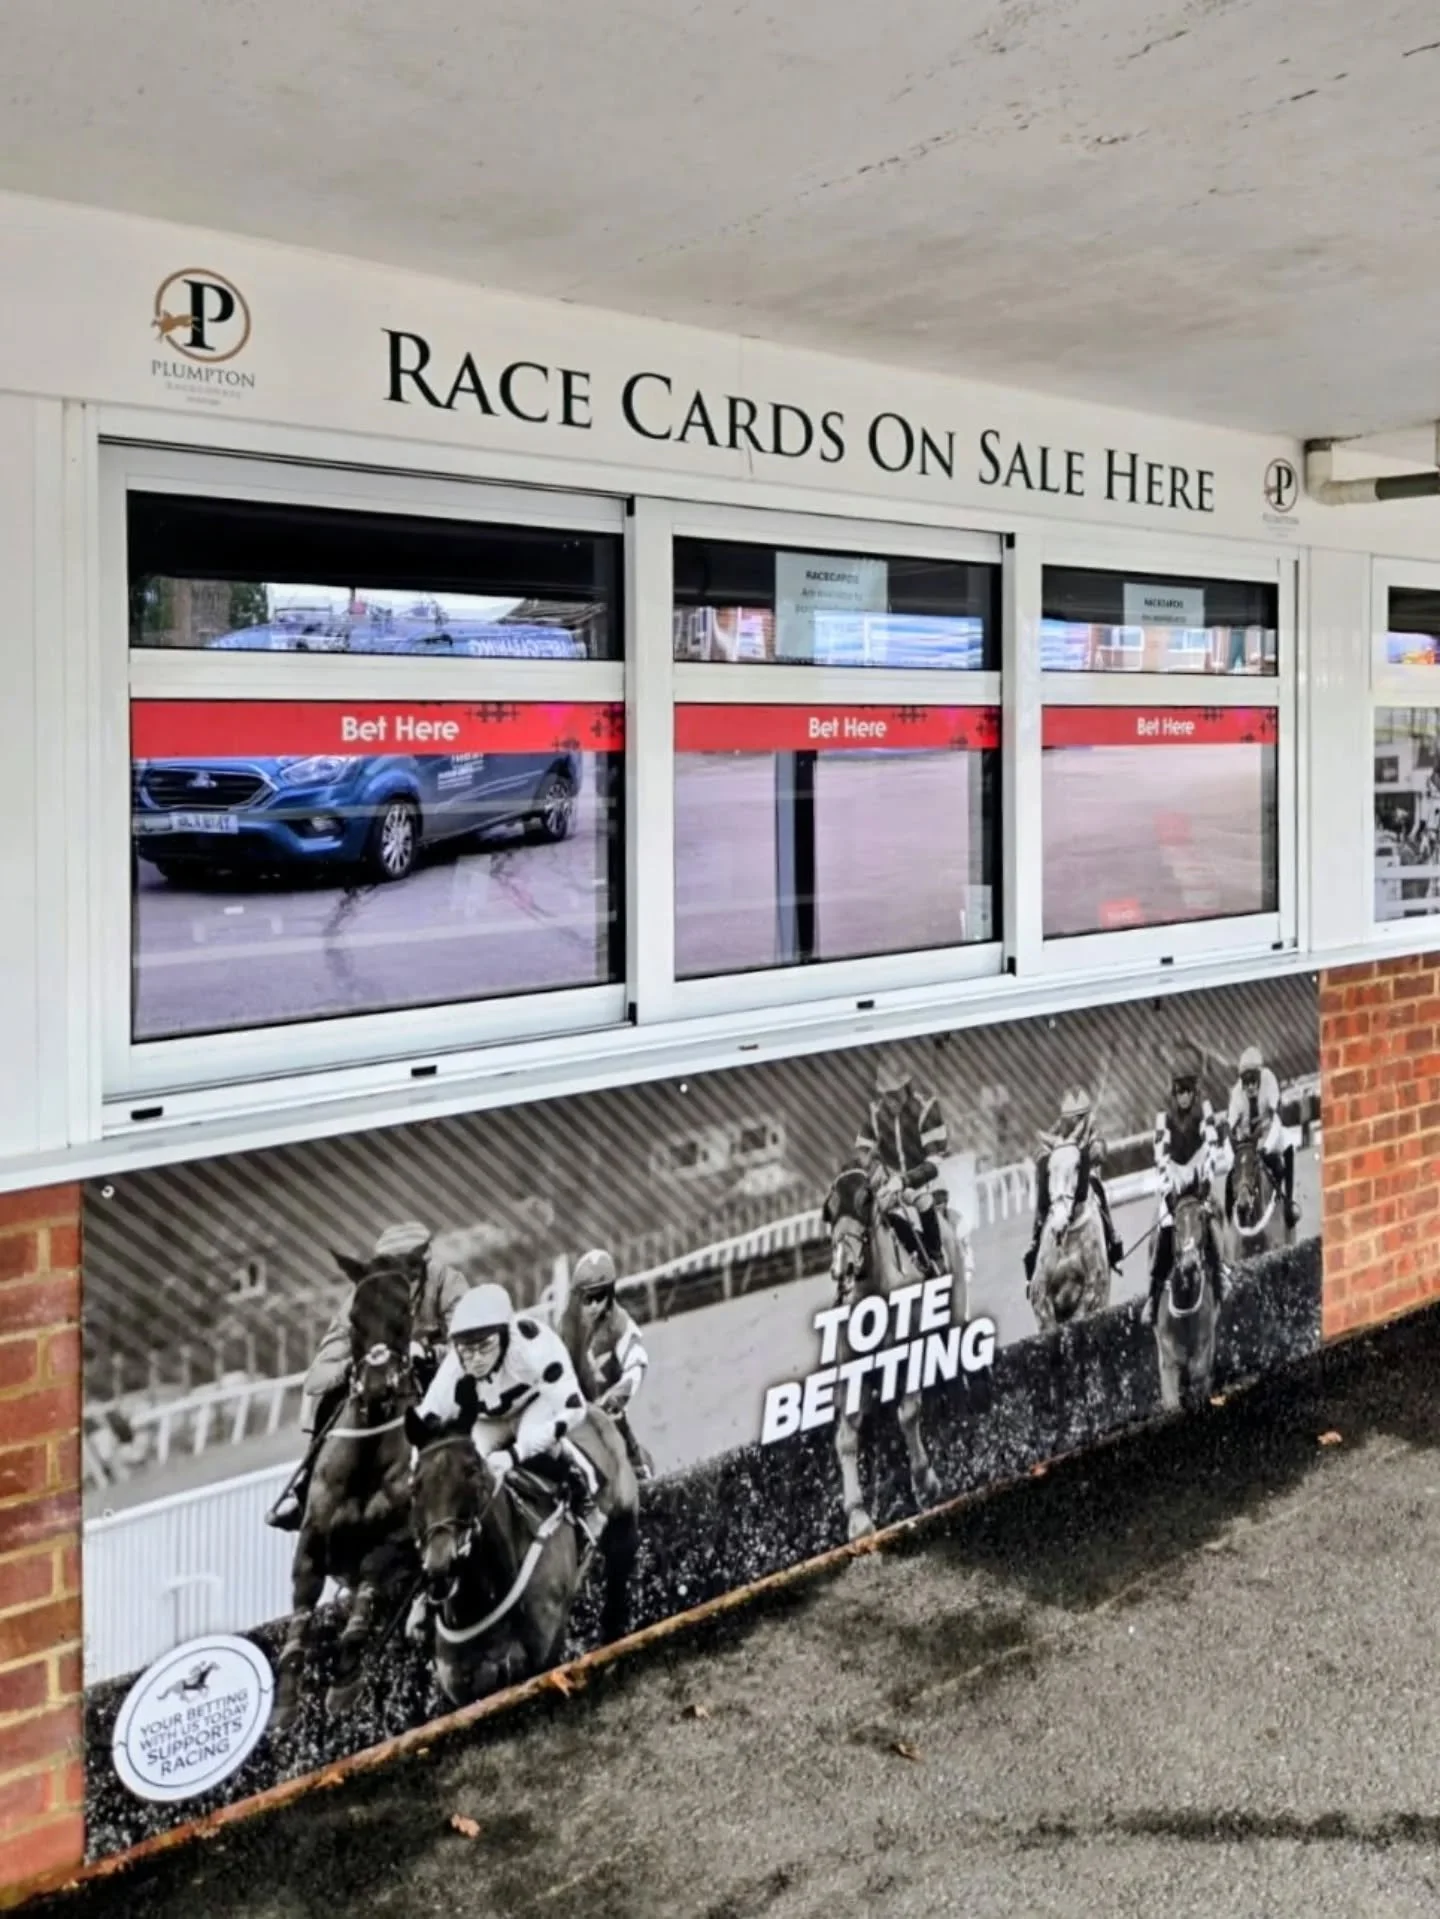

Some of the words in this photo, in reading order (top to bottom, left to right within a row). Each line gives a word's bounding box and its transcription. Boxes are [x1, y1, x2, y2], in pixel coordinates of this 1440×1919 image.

[182, 278, 235, 351] P
[151, 360, 256, 389] PLUMPTON
[380, 328, 593, 430] RACE
[622, 372, 845, 464] CARDS
[868, 413, 957, 479] ON
[978, 429, 1085, 498] SALE
[1104, 448, 1215, 513] HERE
[341, 716, 388, 741] Bet
[395, 716, 460, 741] Here
[808, 717, 839, 738] Bet
[843, 717, 888, 738] Here
[1137, 717, 1160, 736] Bet
[1162, 716, 1195, 736] Here
[813, 1274, 953, 1365] TOTE
[761, 1317, 996, 1446] BETTING
[139, 1729, 177, 1751] WITH
[182, 1721, 200, 1735] US
[203, 1702, 249, 1726] TODAY
[140, 1712, 183, 1738] YOUR
[186, 1688, 248, 1721] BETTING
[146, 1719, 243, 1765] SUPPORTS
[160, 1738, 230, 1777] RACING
